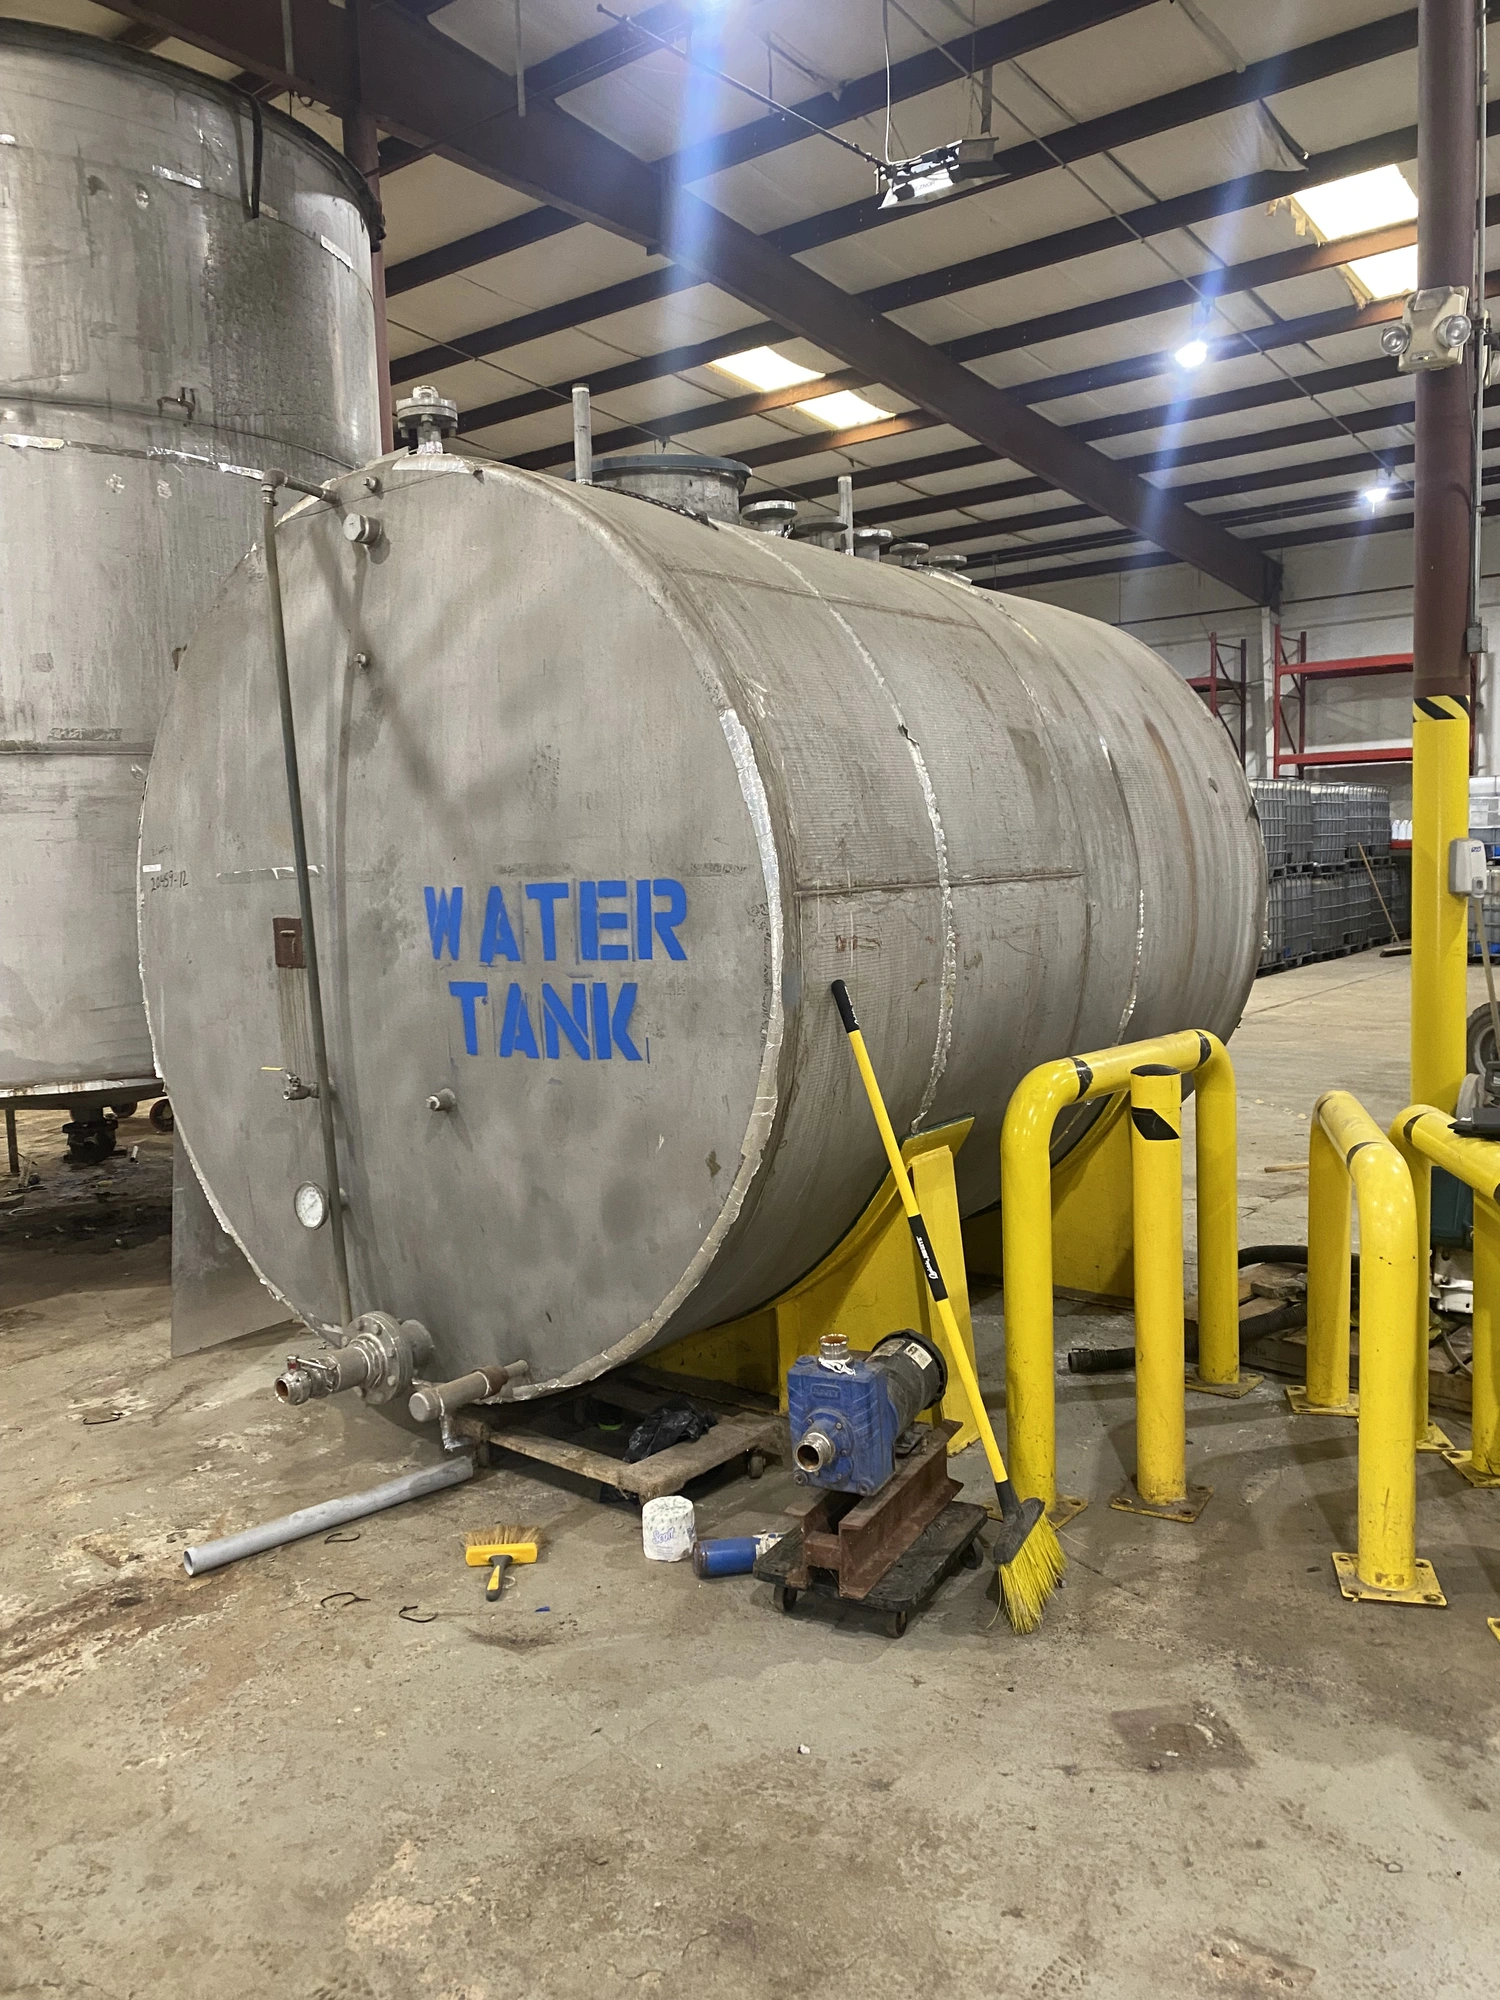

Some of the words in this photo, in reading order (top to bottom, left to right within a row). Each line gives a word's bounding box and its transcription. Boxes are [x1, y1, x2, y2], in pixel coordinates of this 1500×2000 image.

[423, 878, 688, 964] WATER
[448, 981, 643, 1062] TANK
[652, 1526, 675, 1545] Scott
